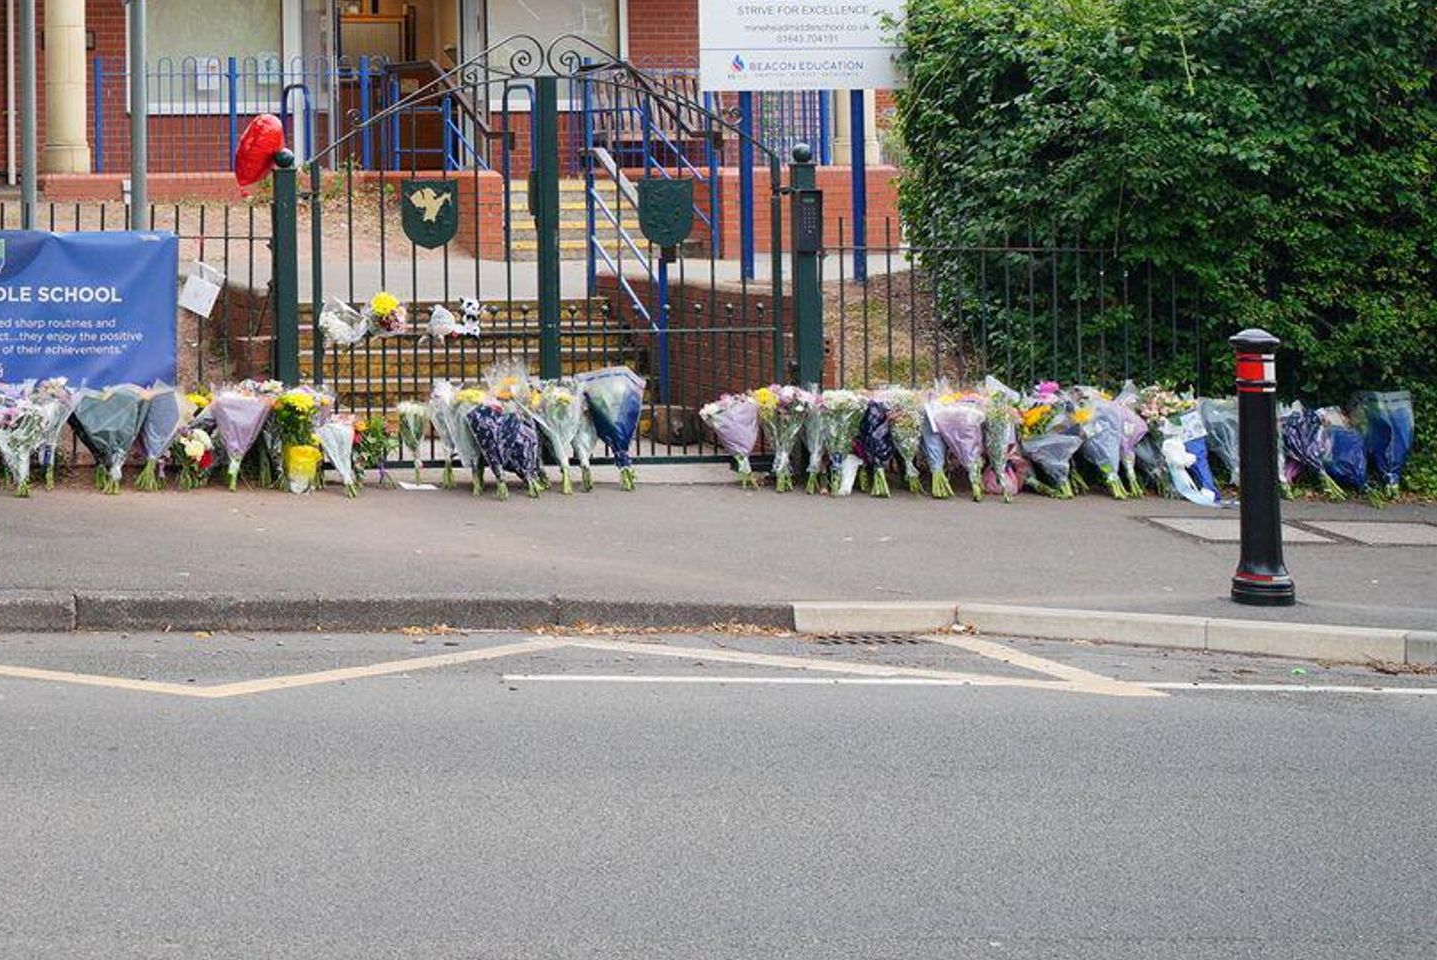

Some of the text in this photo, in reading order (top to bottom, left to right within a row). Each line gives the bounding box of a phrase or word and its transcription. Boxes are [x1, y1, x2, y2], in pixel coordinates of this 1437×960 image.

[737, 6, 869, 15] STRIVE FOR EXCELLENCE
[749, 60, 864, 71] BEACON EDUCATION
[38, 287, 122, 303] SCHOOL
[14, 319, 46, 330] sharp
[48, 319, 93, 329] routines
[95, 319, 116, 329] and
[46, 332, 76, 343] enjoy
[79, 332, 98, 342] the
[100, 331, 143, 343] positive
[2, 345, 15, 355] of
[16, 345, 42, 355] their
